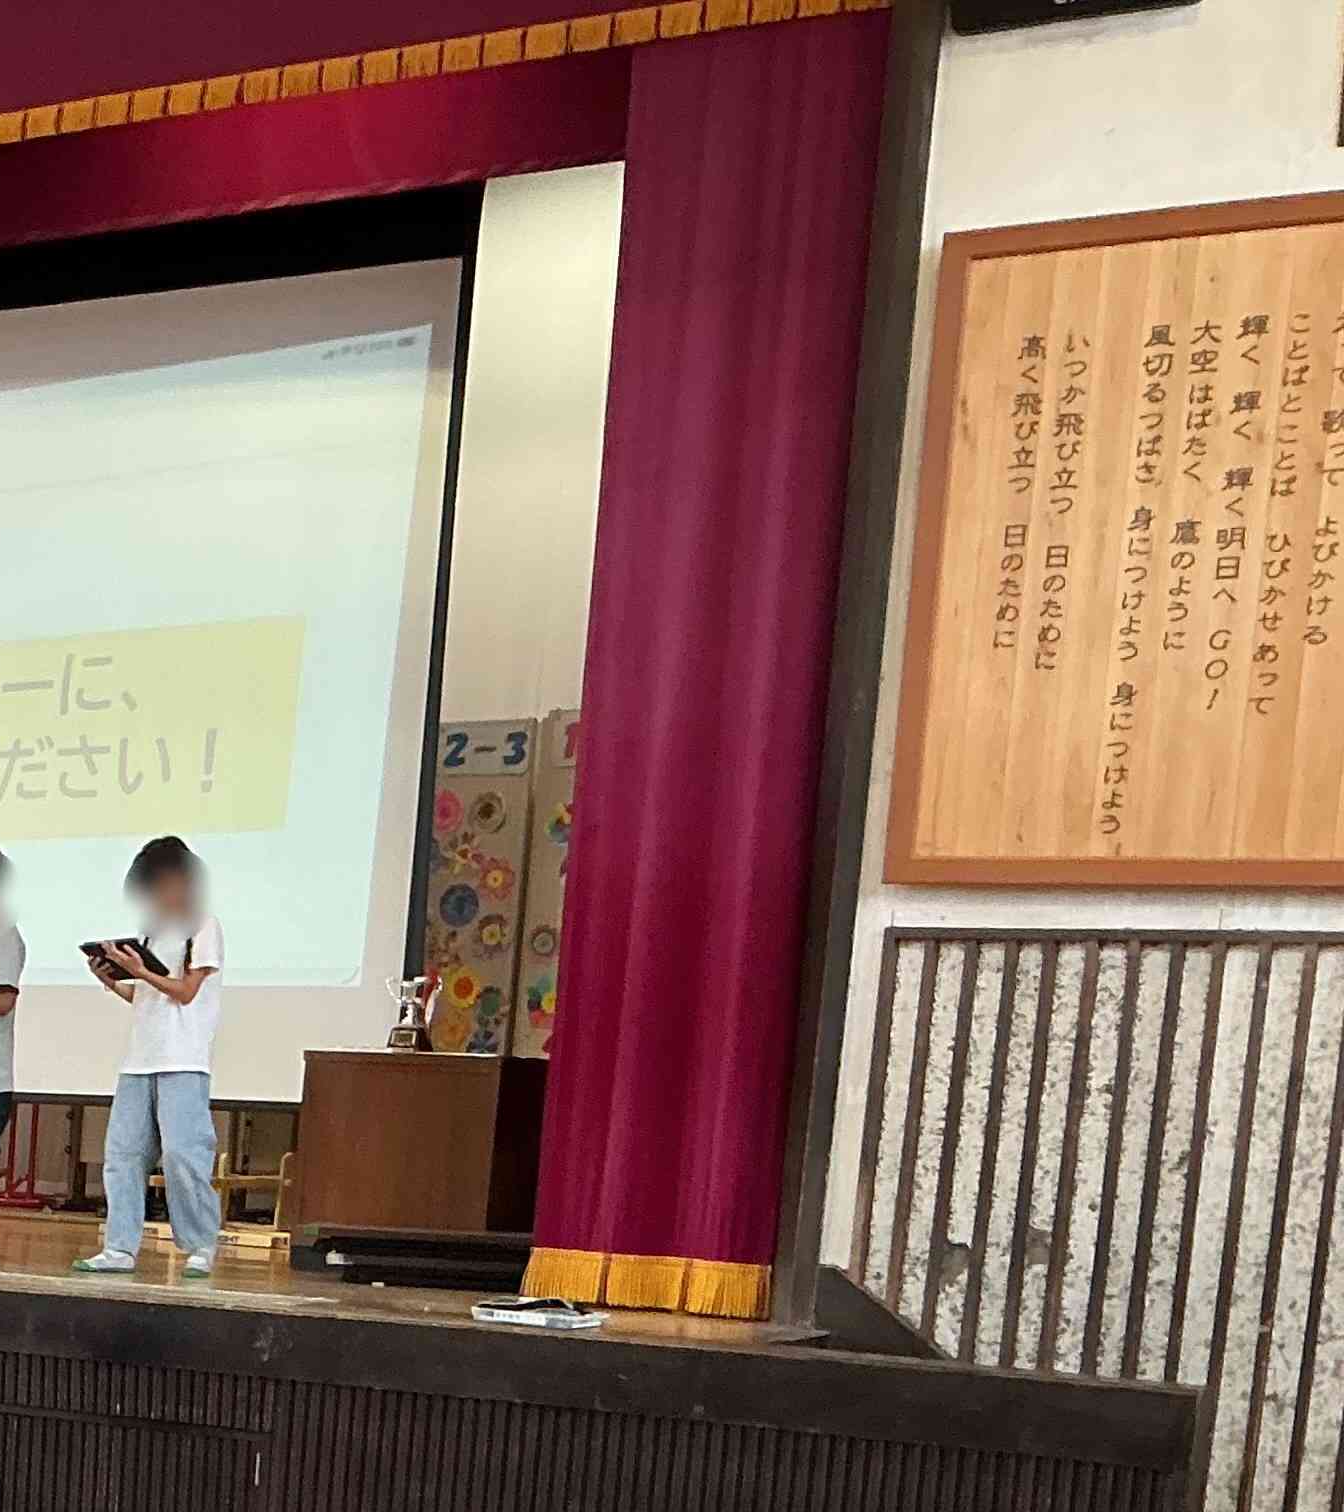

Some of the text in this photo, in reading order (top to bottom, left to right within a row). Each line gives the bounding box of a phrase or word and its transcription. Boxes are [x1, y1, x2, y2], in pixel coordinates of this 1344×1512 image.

[1235, 314, 1270, 366] 輝く
[1229, 390, 1262, 441] 輝く
[1034, 332, 1091, 671] いつか飛び立つ 日のために
[1162, 319, 1222, 651] 大空はばたく 鷹のように
[1212, 466, 1255, 604] 輝く明日へ
[1248, 312, 1312, 715] ことばとことば ひびかせあって
[992, 524, 1028, 650] 日のために
[1117, 505, 1156, 662] 身につけよう
[1303, 515, 1340, 646] よびかける
